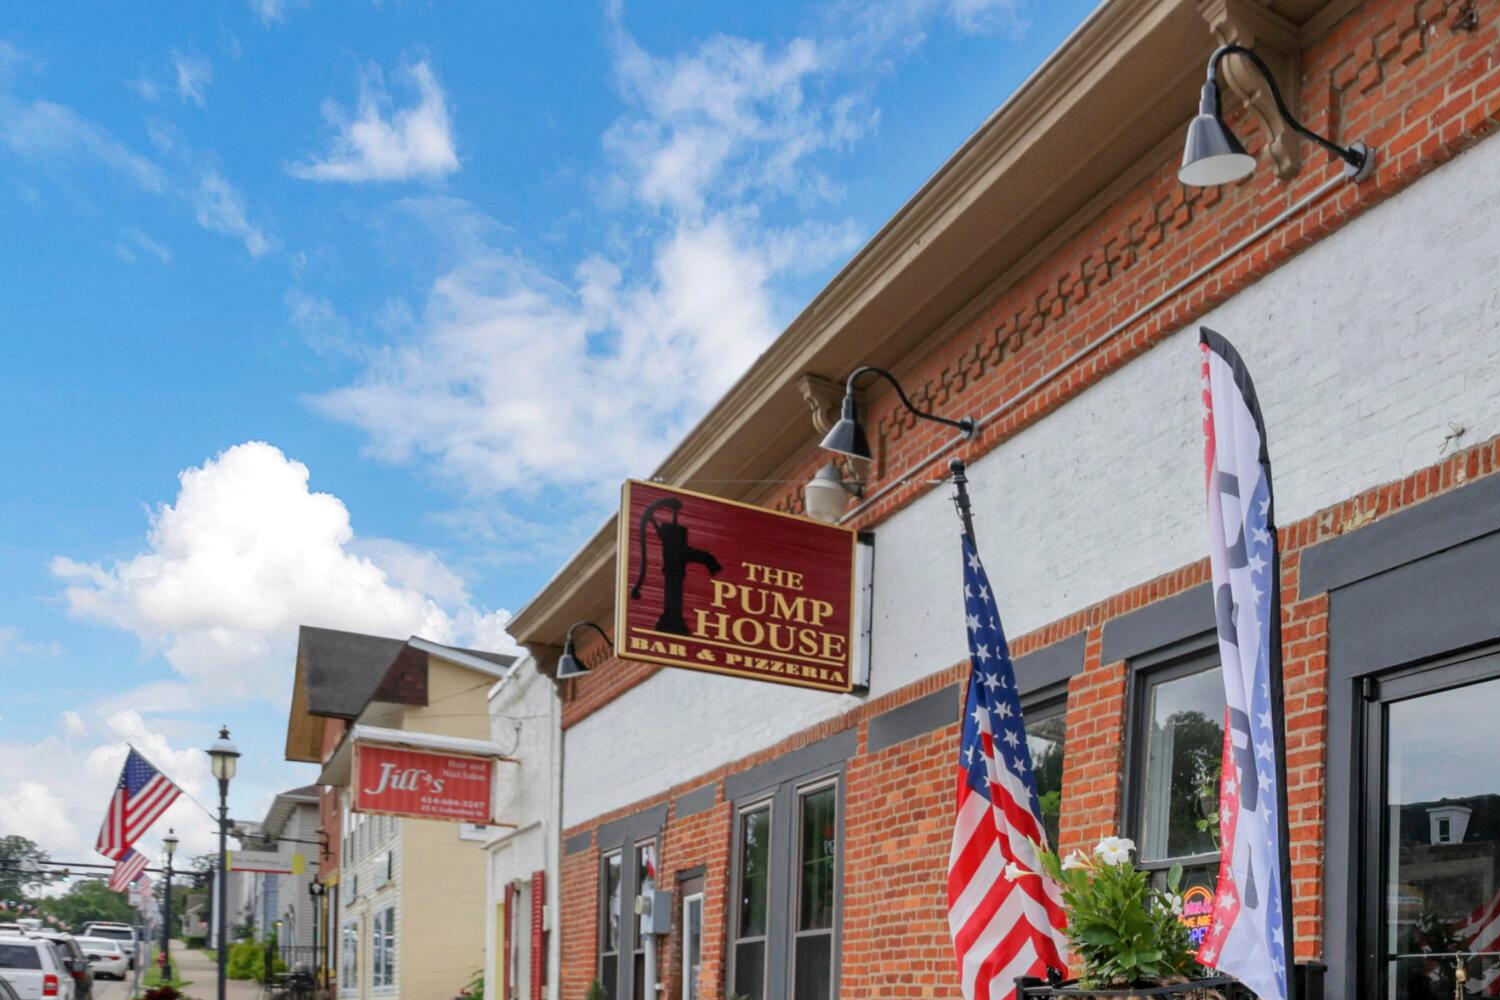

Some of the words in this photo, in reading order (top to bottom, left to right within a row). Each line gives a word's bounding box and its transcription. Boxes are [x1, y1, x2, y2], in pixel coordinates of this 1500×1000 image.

[741, 562, 804, 591] THE
[710, 579, 833, 626] PUMP
[692, 608, 846, 661] HOUSE
[630, 636, 687, 657] BAR
[696, 648, 716, 661] &
[725, 653, 844, 683] PIZZERIA
[364, 762, 445, 795] Jill's
